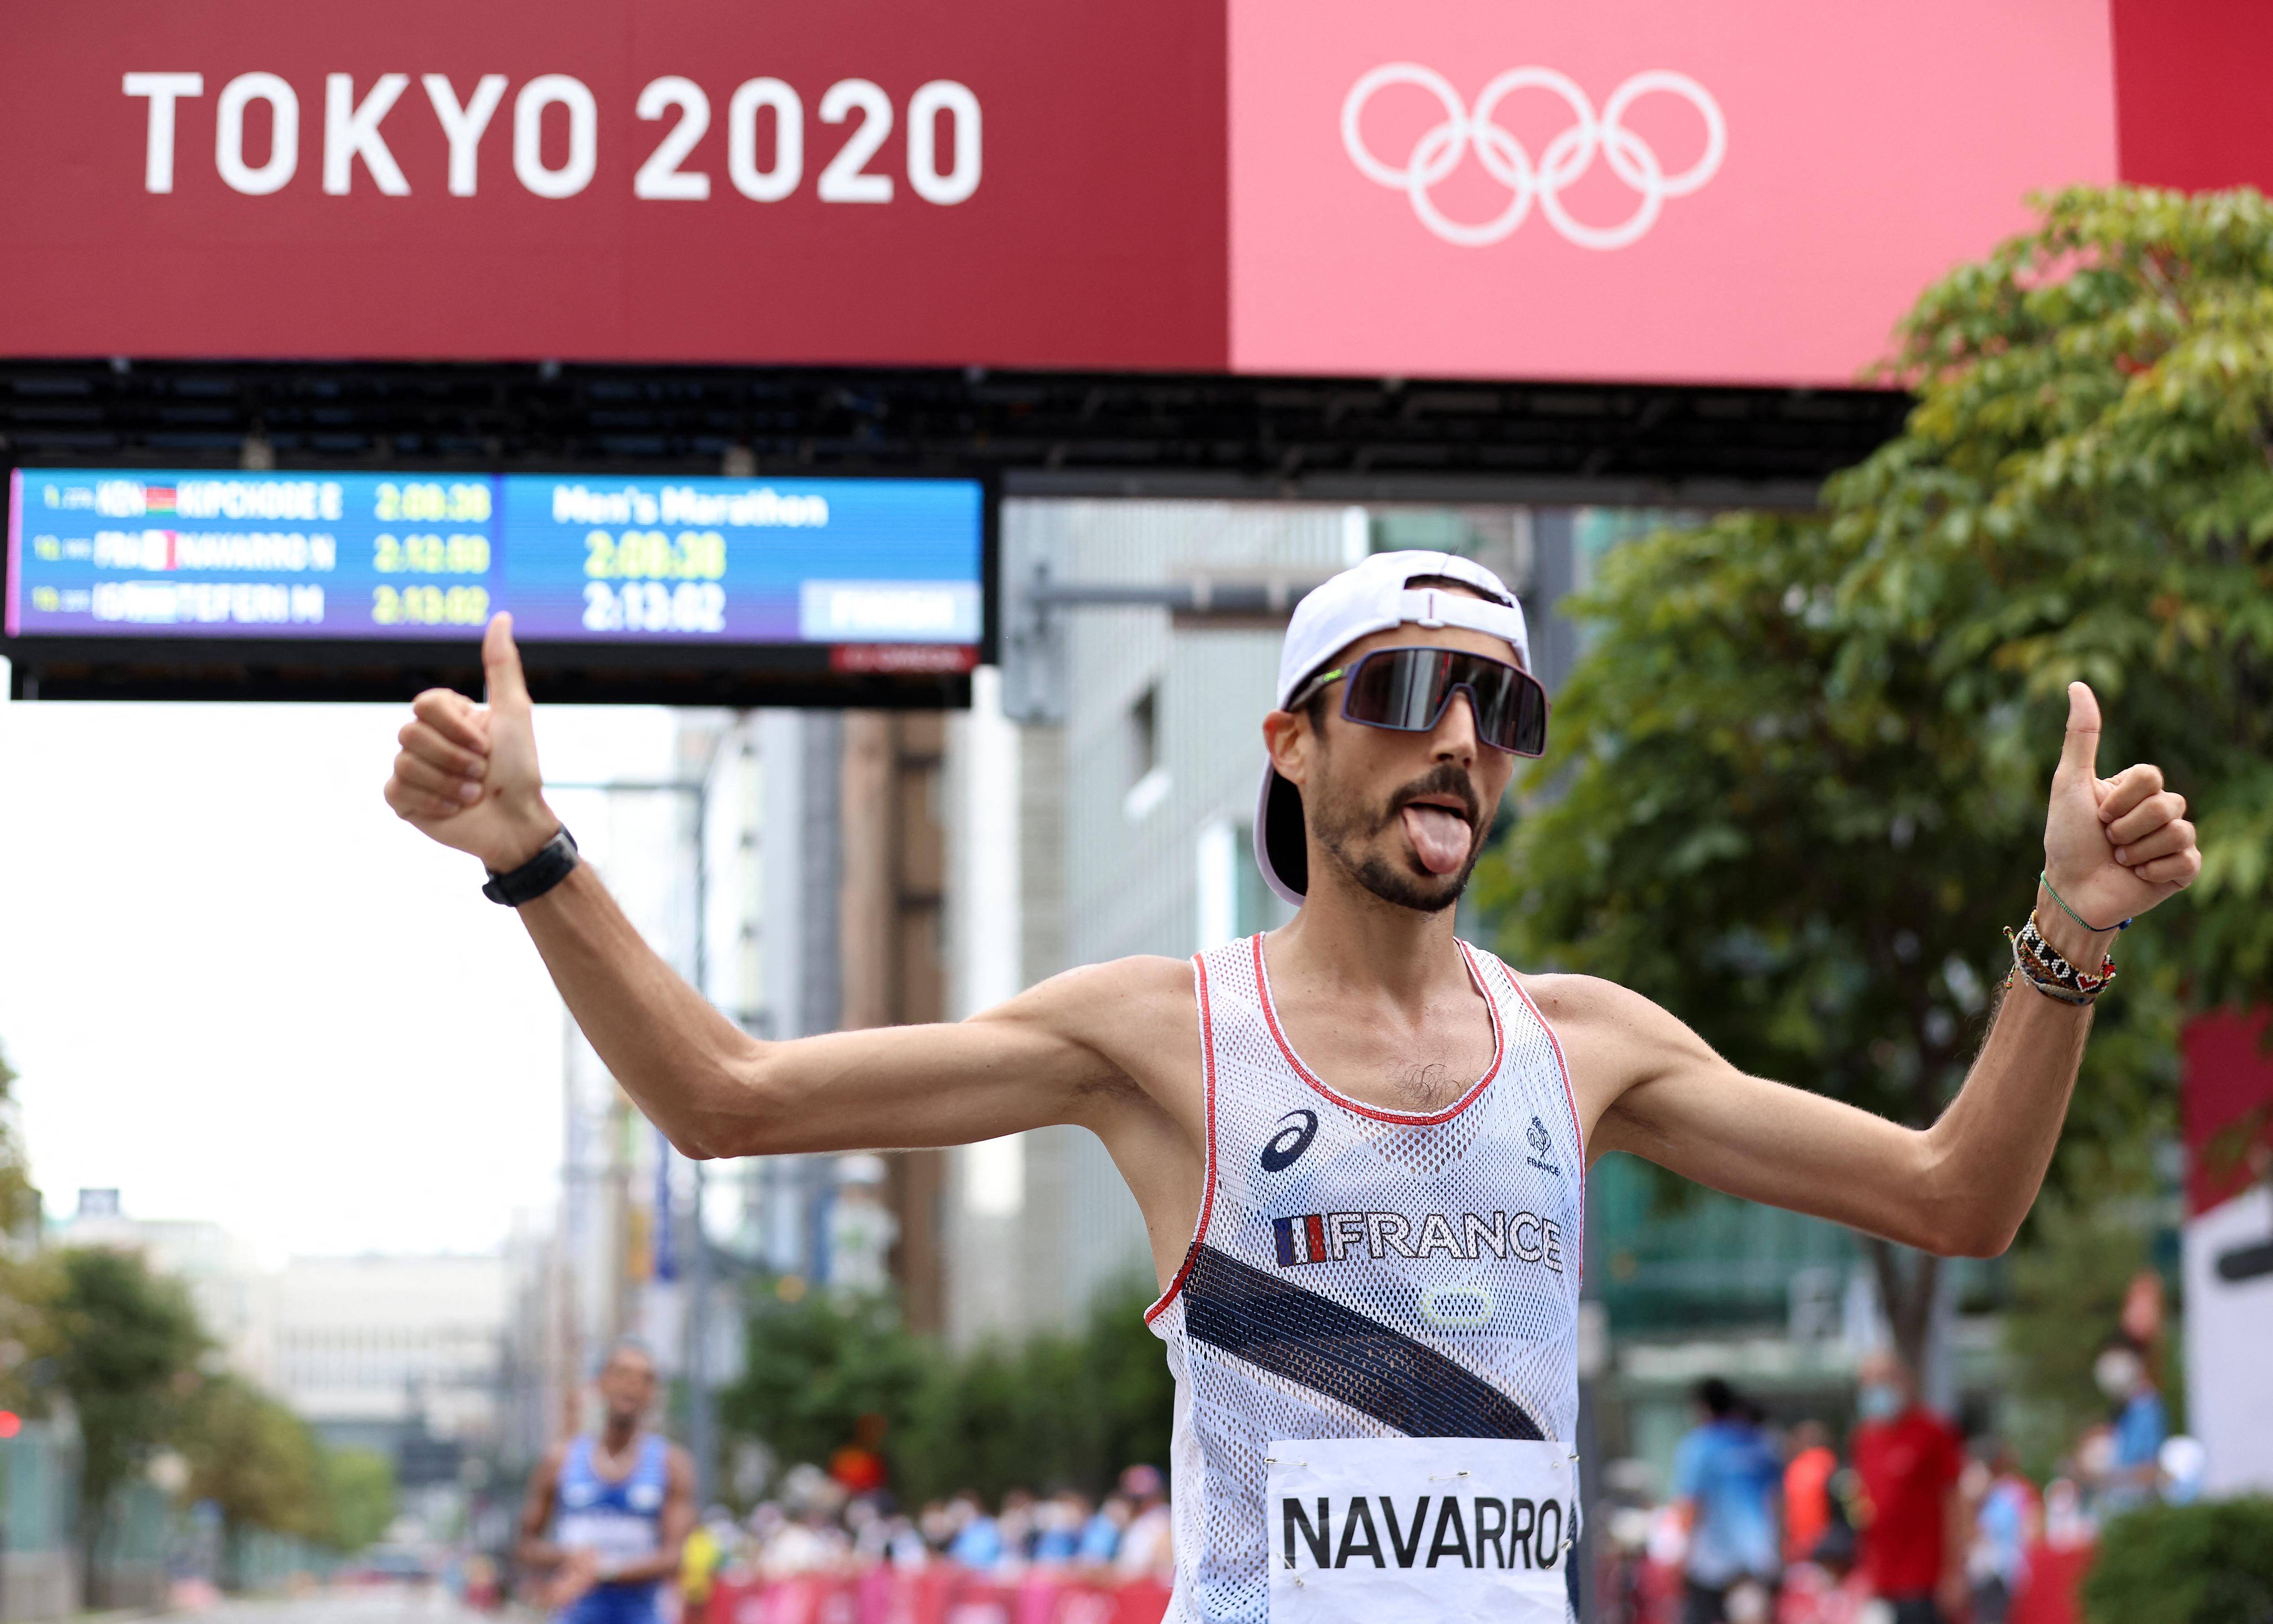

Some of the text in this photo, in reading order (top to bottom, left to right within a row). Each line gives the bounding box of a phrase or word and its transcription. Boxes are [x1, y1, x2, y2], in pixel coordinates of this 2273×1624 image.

[122, 71, 984, 206] TOKYO 2020
[661, 486, 829, 528] Marathon
[1527, 1156, 1560, 1177] FRANCE
[1327, 1211, 1563, 1273] FRANCE
[1282, 1496, 1561, 1569] NAVARRO
